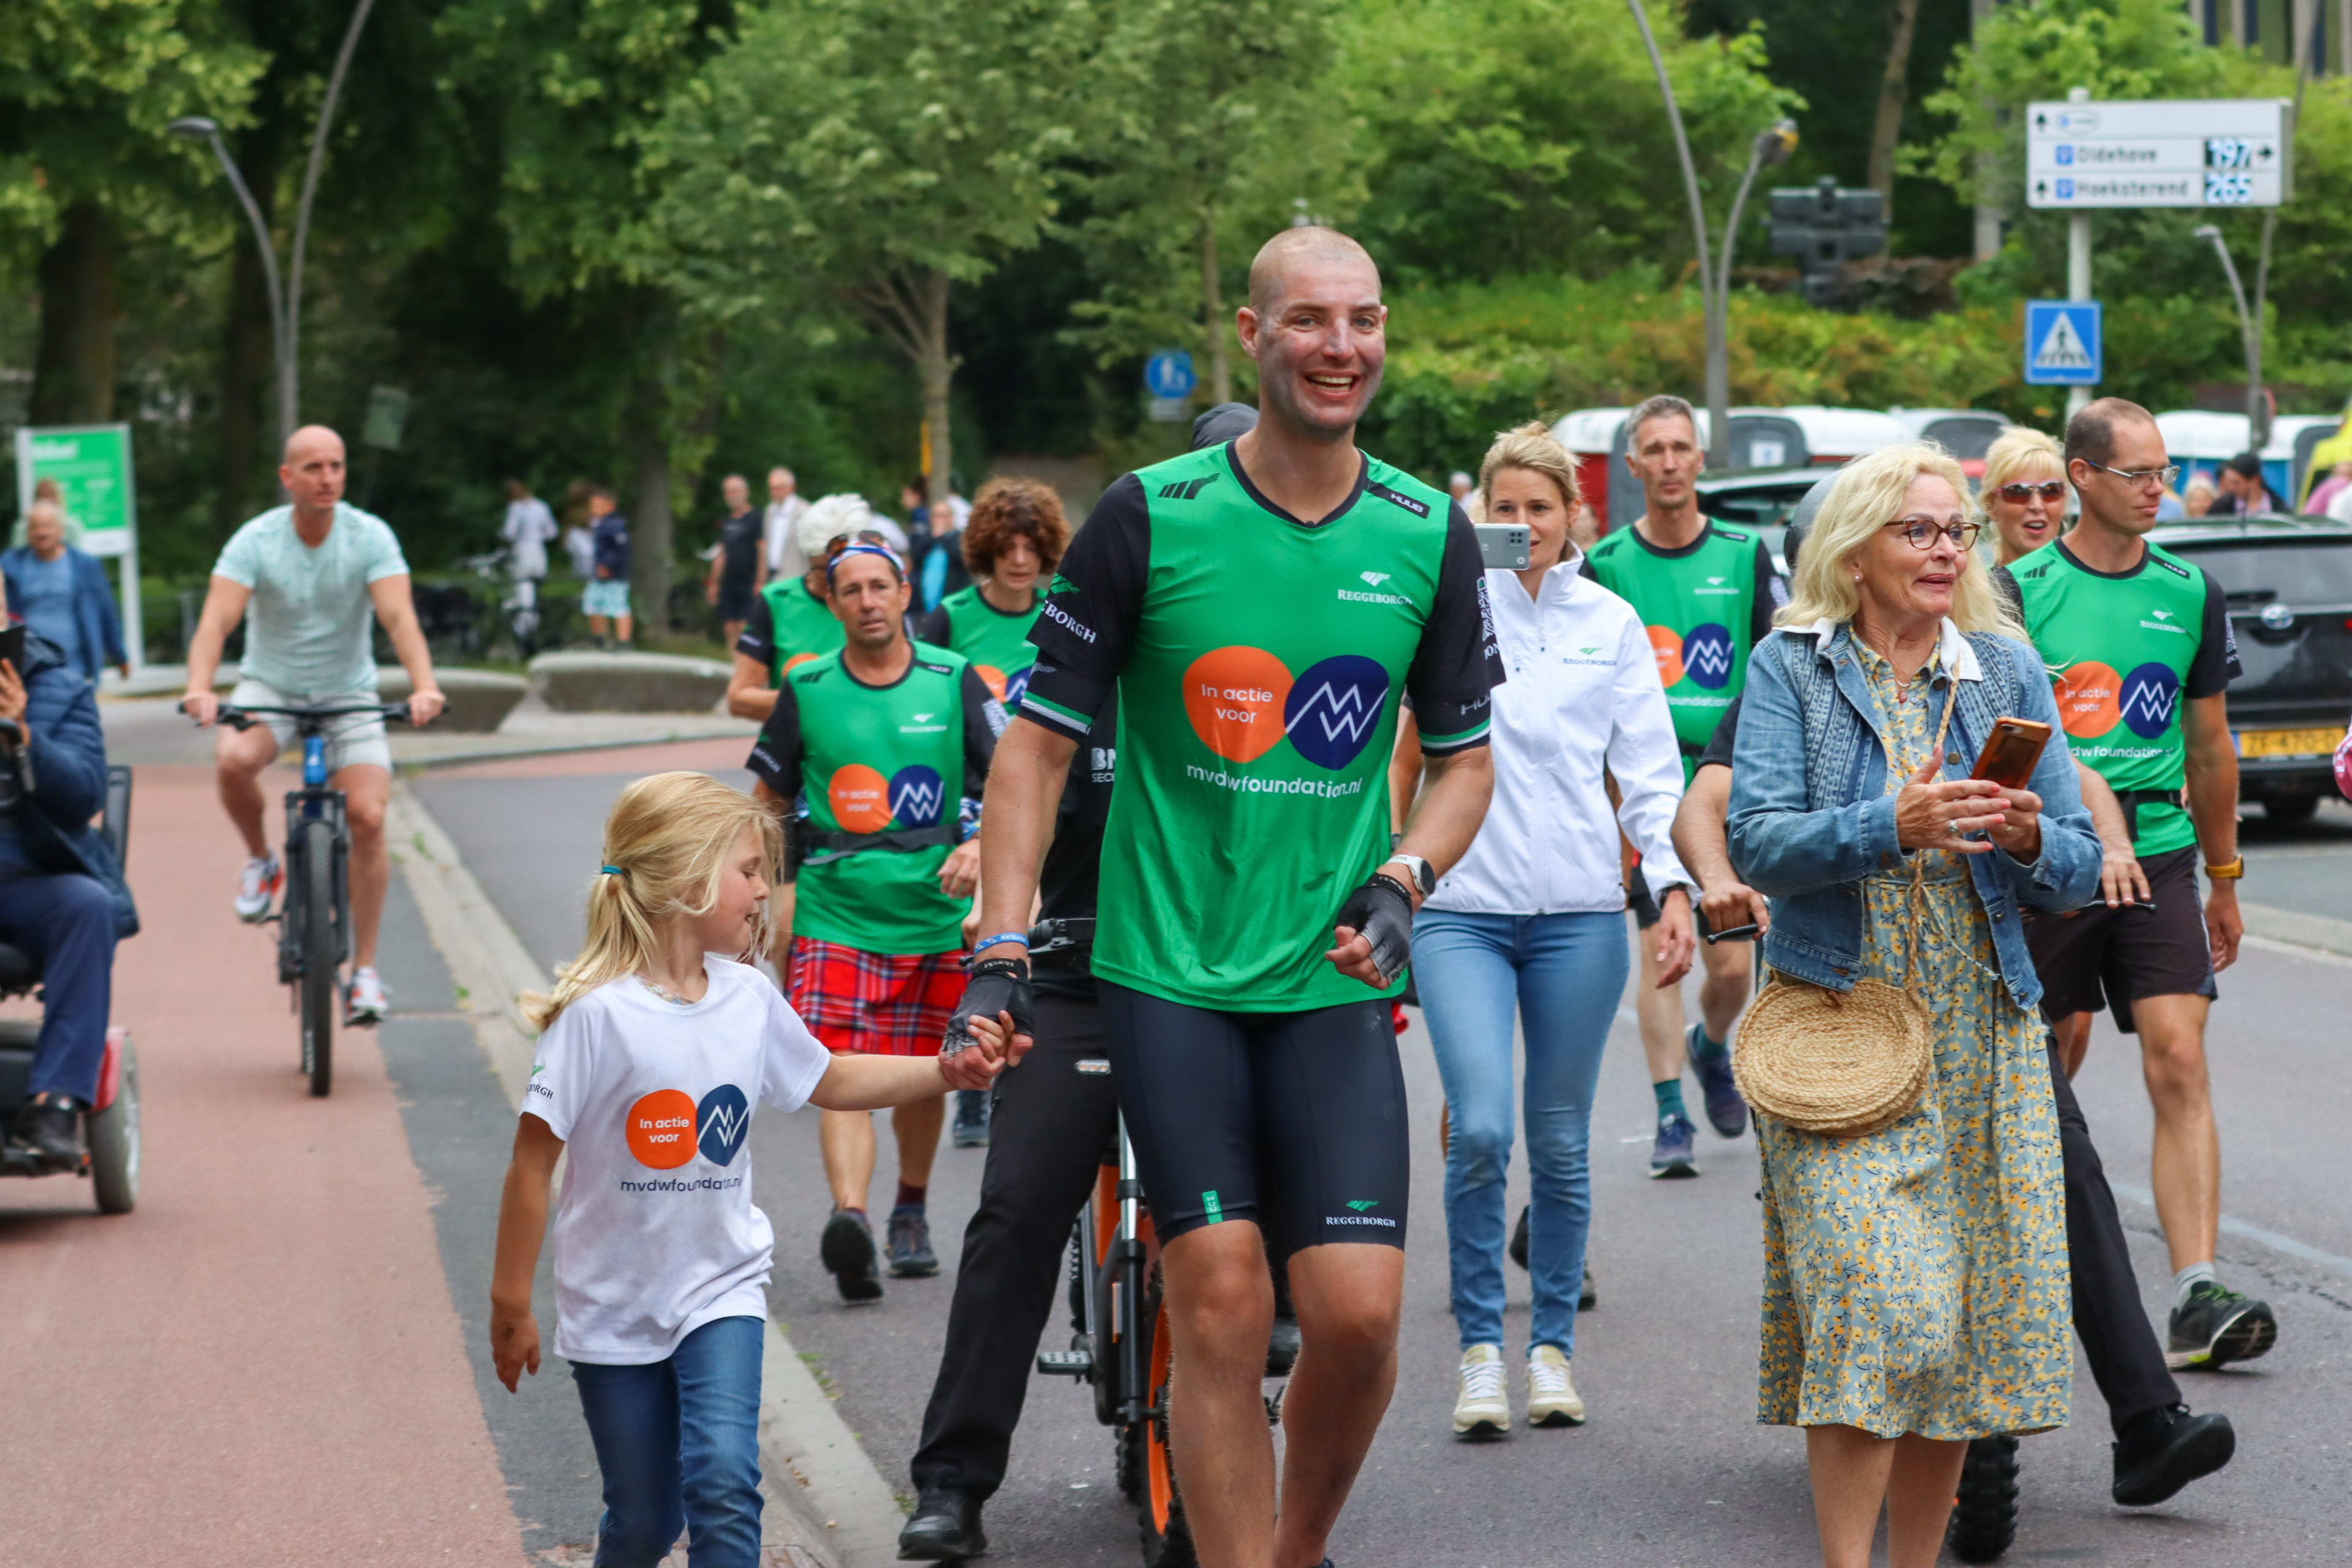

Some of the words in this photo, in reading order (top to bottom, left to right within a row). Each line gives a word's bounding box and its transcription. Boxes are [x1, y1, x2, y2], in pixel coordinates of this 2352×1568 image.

[2209, 138, 2252, 168] 197
[2205, 173, 2252, 203] 265
[1390, 493, 1424, 513] HUUB
[1201, 684, 1218, 698] In
[1223, 687, 1273, 703] actie
[1215, 707, 1257, 724] voor
[1186, 764, 1363, 799] mvdwfoundation.nl
[639, 1118, 652, 1129] In
[655, 1116, 690, 1128] actie
[649, 1133, 680, 1144] voor
[1325, 1216, 1396, 1227] REGGEBORGH
